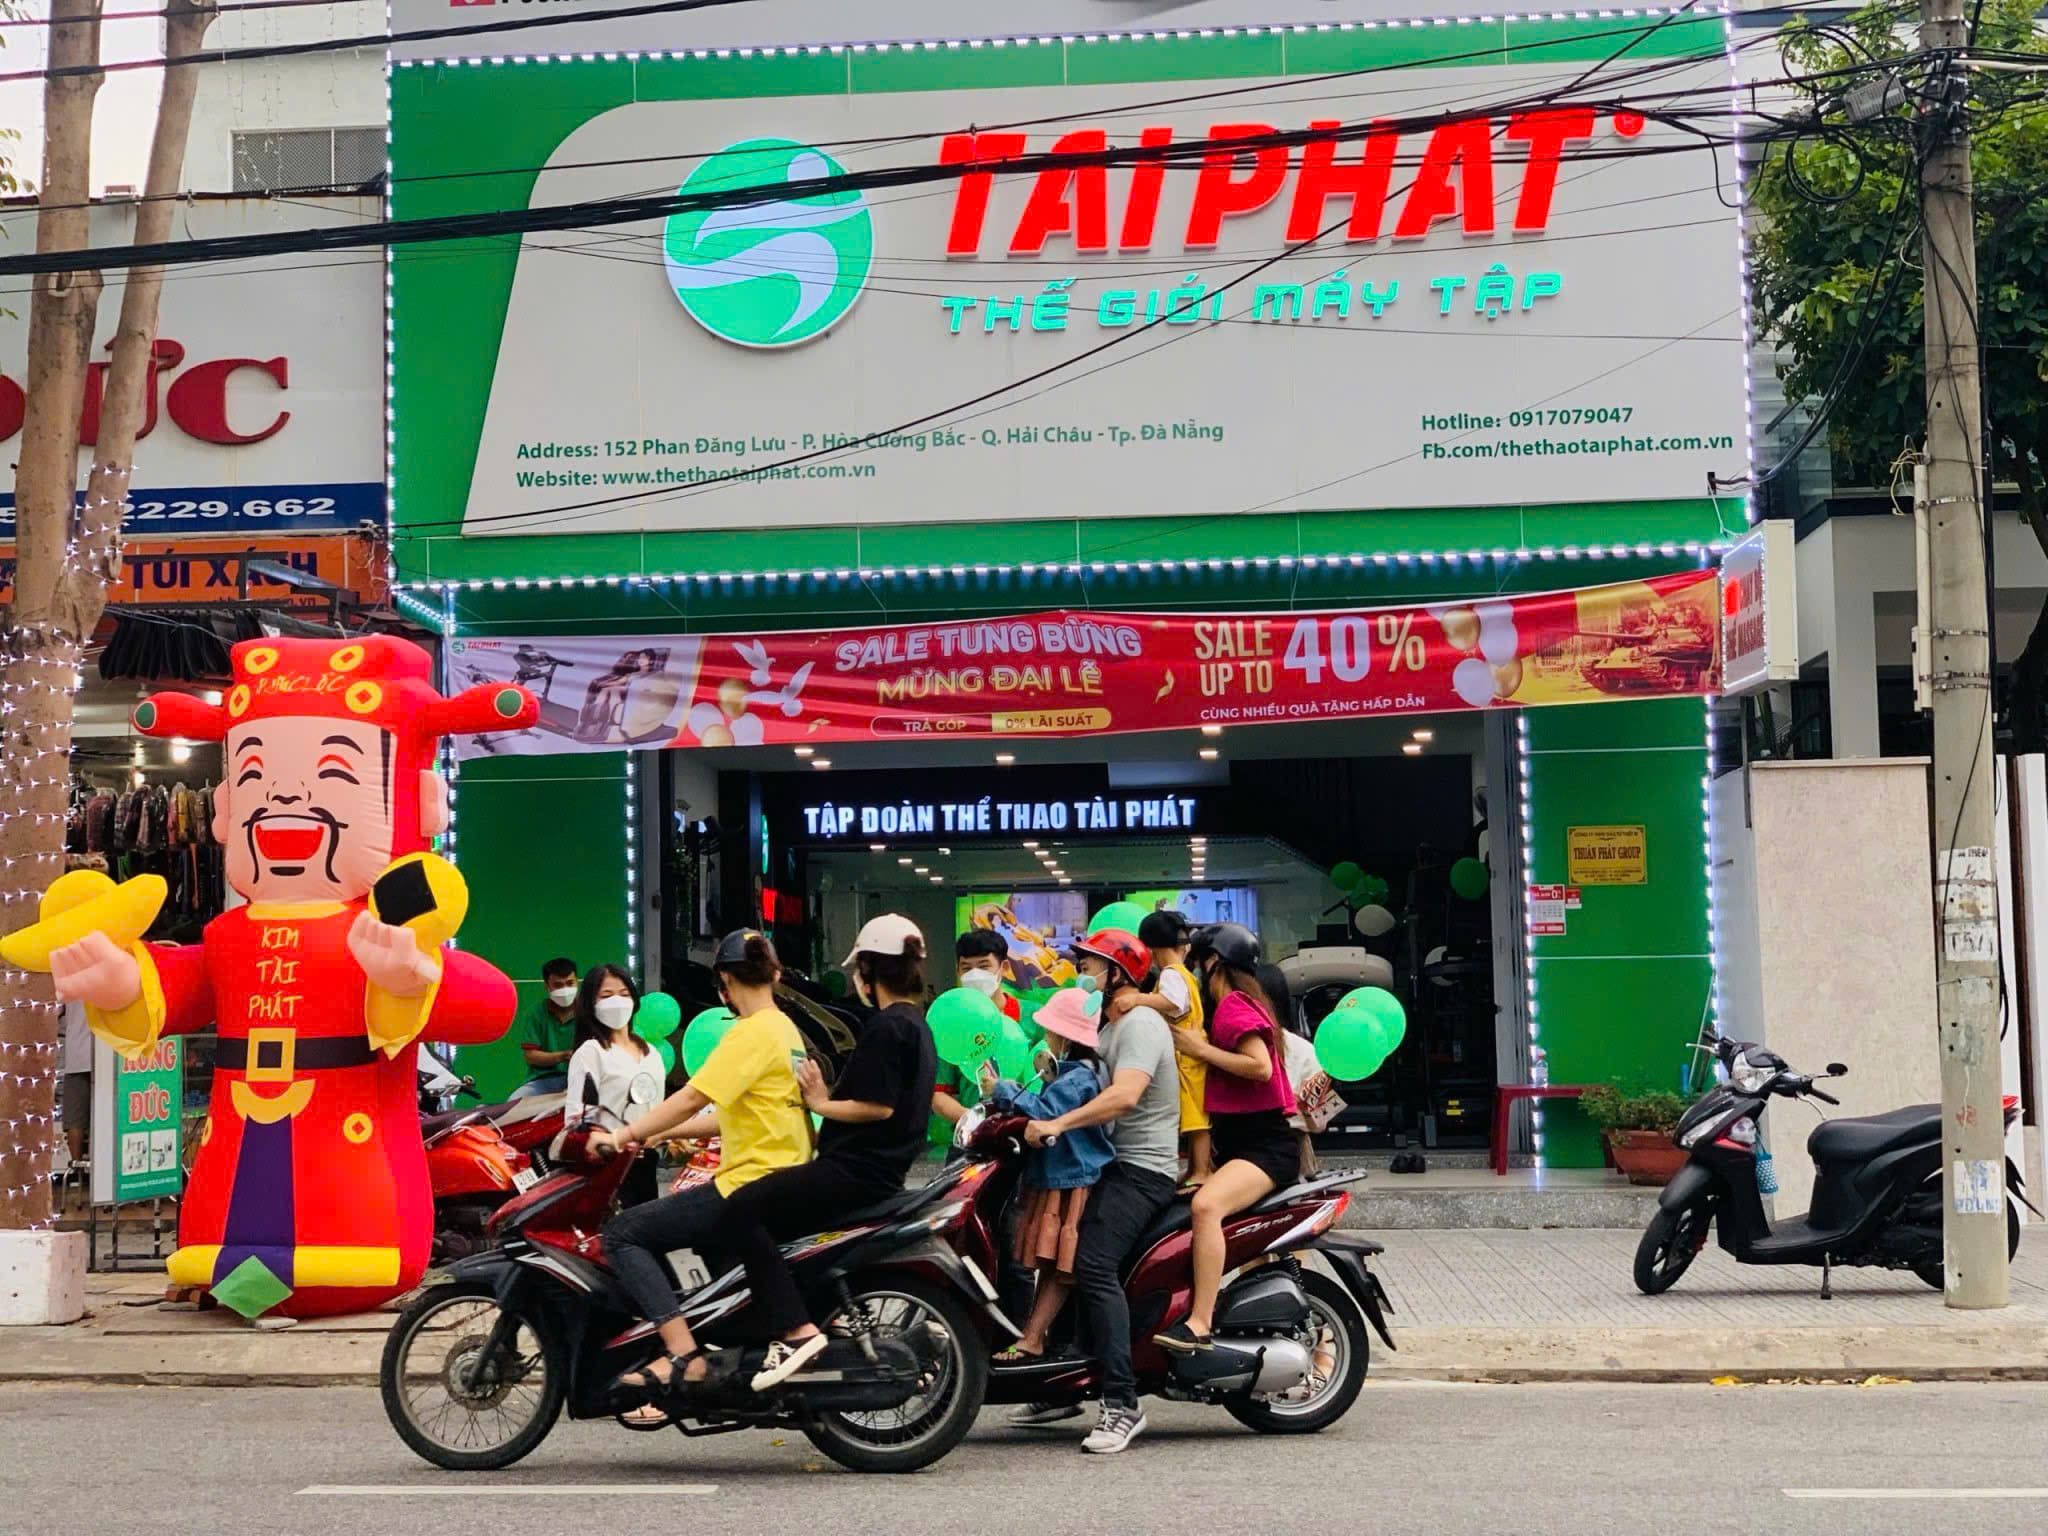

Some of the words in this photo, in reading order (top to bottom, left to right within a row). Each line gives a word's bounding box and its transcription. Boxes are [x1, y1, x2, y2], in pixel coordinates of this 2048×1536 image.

[942, 277, 1079, 333] THẾ
[1099, 271, 1224, 328] GIỚI
[1252, 268, 1400, 321] MÁY
[1430, 262, 1562, 319] TẬP
[1421, 413, 1501, 430] Hotline:
[1509, 407, 1634, 427] 0917079047
[516, 442, 598, 459] Address:
[604, 441, 638, 456] 152
[643, 438, 690, 455] Phan
[695, 437, 745, 456] Đăng
[752, 436, 786, 451] Lưu
[802, 433, 817, 449] P.
[823, 432, 860, 449] Hòa
[932, 427, 965, 447] Bắc
[981, 429, 1002, 446] Q.
[1007, 428, 1039, 443] Hải
[1043, 427, 1092, 443] Châu
[1107, 426, 1136, 447] Tp.
[1140, 424, 1167, 440] Đà
[1172, 418, 1224, 442] Nẵng
[1422, 435, 1733, 459] Fb.com/thethaotaiphat.com.vn
[516, 470, 598, 487] Website:
[602, 463, 876, 489] www.thethaotaiphat.com.vn
[131, 549, 190, 589] TÚI
[834, 629, 931, 671] SALE
[1041, 616, 1143, 658] BỪNG
[1194, 620, 1273, 661] SALE
[877, 667, 985, 704] MỪNG
[989, 664, 1052, 697] ĐẠI
[1061, 658, 1104, 695] LỄ
[1200, 662, 1233, 697] UP
[1240, 660, 1273, 694] TO
[1030, 714, 1053, 728] LÃI
[1056, 711, 1094, 727] SUẤT
[1200, 705, 1240, 721] CÙNG
[1288, 700, 1319, 716] QUÀ
[1322, 699, 1360, 715] TẶNG
[1363, 696, 1391, 710] HẤP
[1395, 692, 1425, 708] DẪN
[804, 802, 854, 839] TẬP
[861, 800, 933, 834] ĐOÀN
[997, 803, 1067, 831] THAO
[1074, 796, 1118, 830] TÀI
[1126, 794, 1195, 829] PHÁT
[261, 927, 299, 950] KIM
[256, 956, 300, 985] TÀI
[248, 991, 303, 1019] PHÁT
[129, 1081, 170, 1125] ĐỨC
